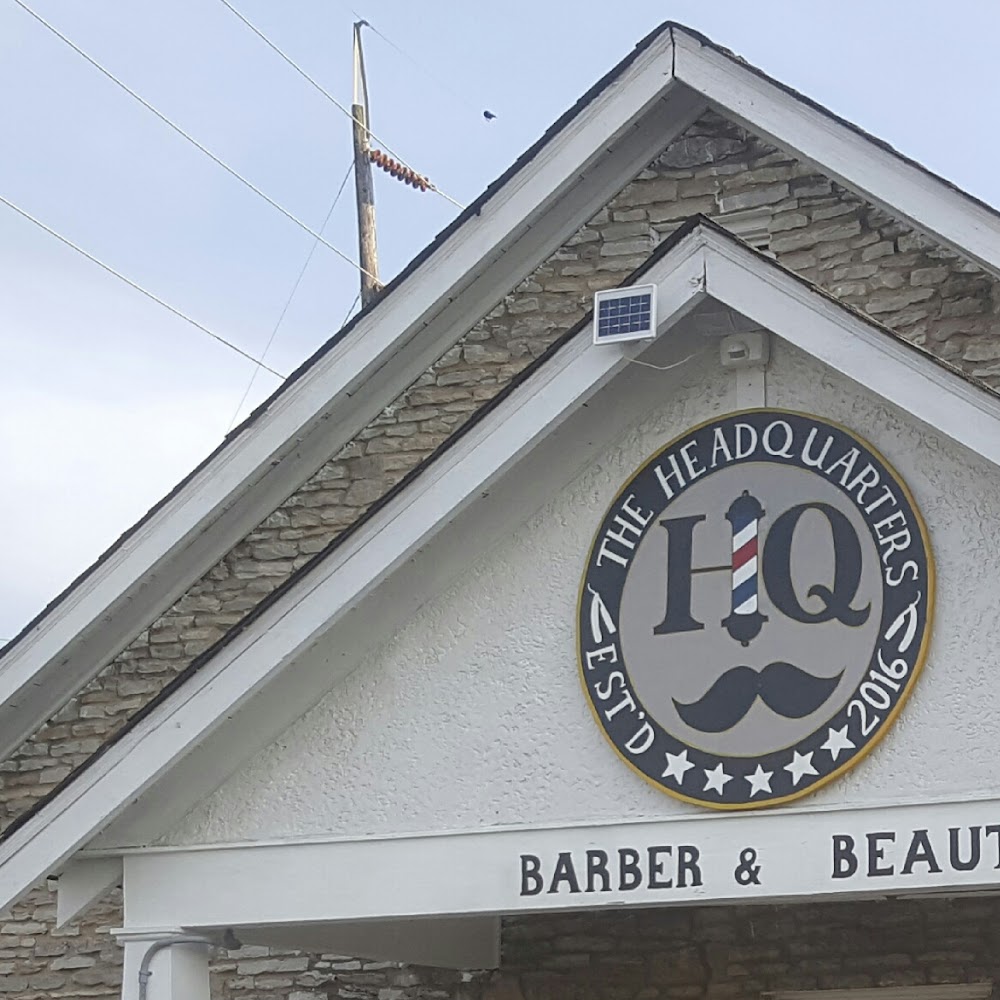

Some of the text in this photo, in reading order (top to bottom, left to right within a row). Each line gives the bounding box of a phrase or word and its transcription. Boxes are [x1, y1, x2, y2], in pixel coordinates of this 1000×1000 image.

[596, 419, 919, 588] THE HEADQUARTERS
[653, 492, 872, 642] HQ
[586, 643, 908, 755] EST'D 2016
[519, 845, 703, 896] BARBER
[734, 847, 762, 886] &
